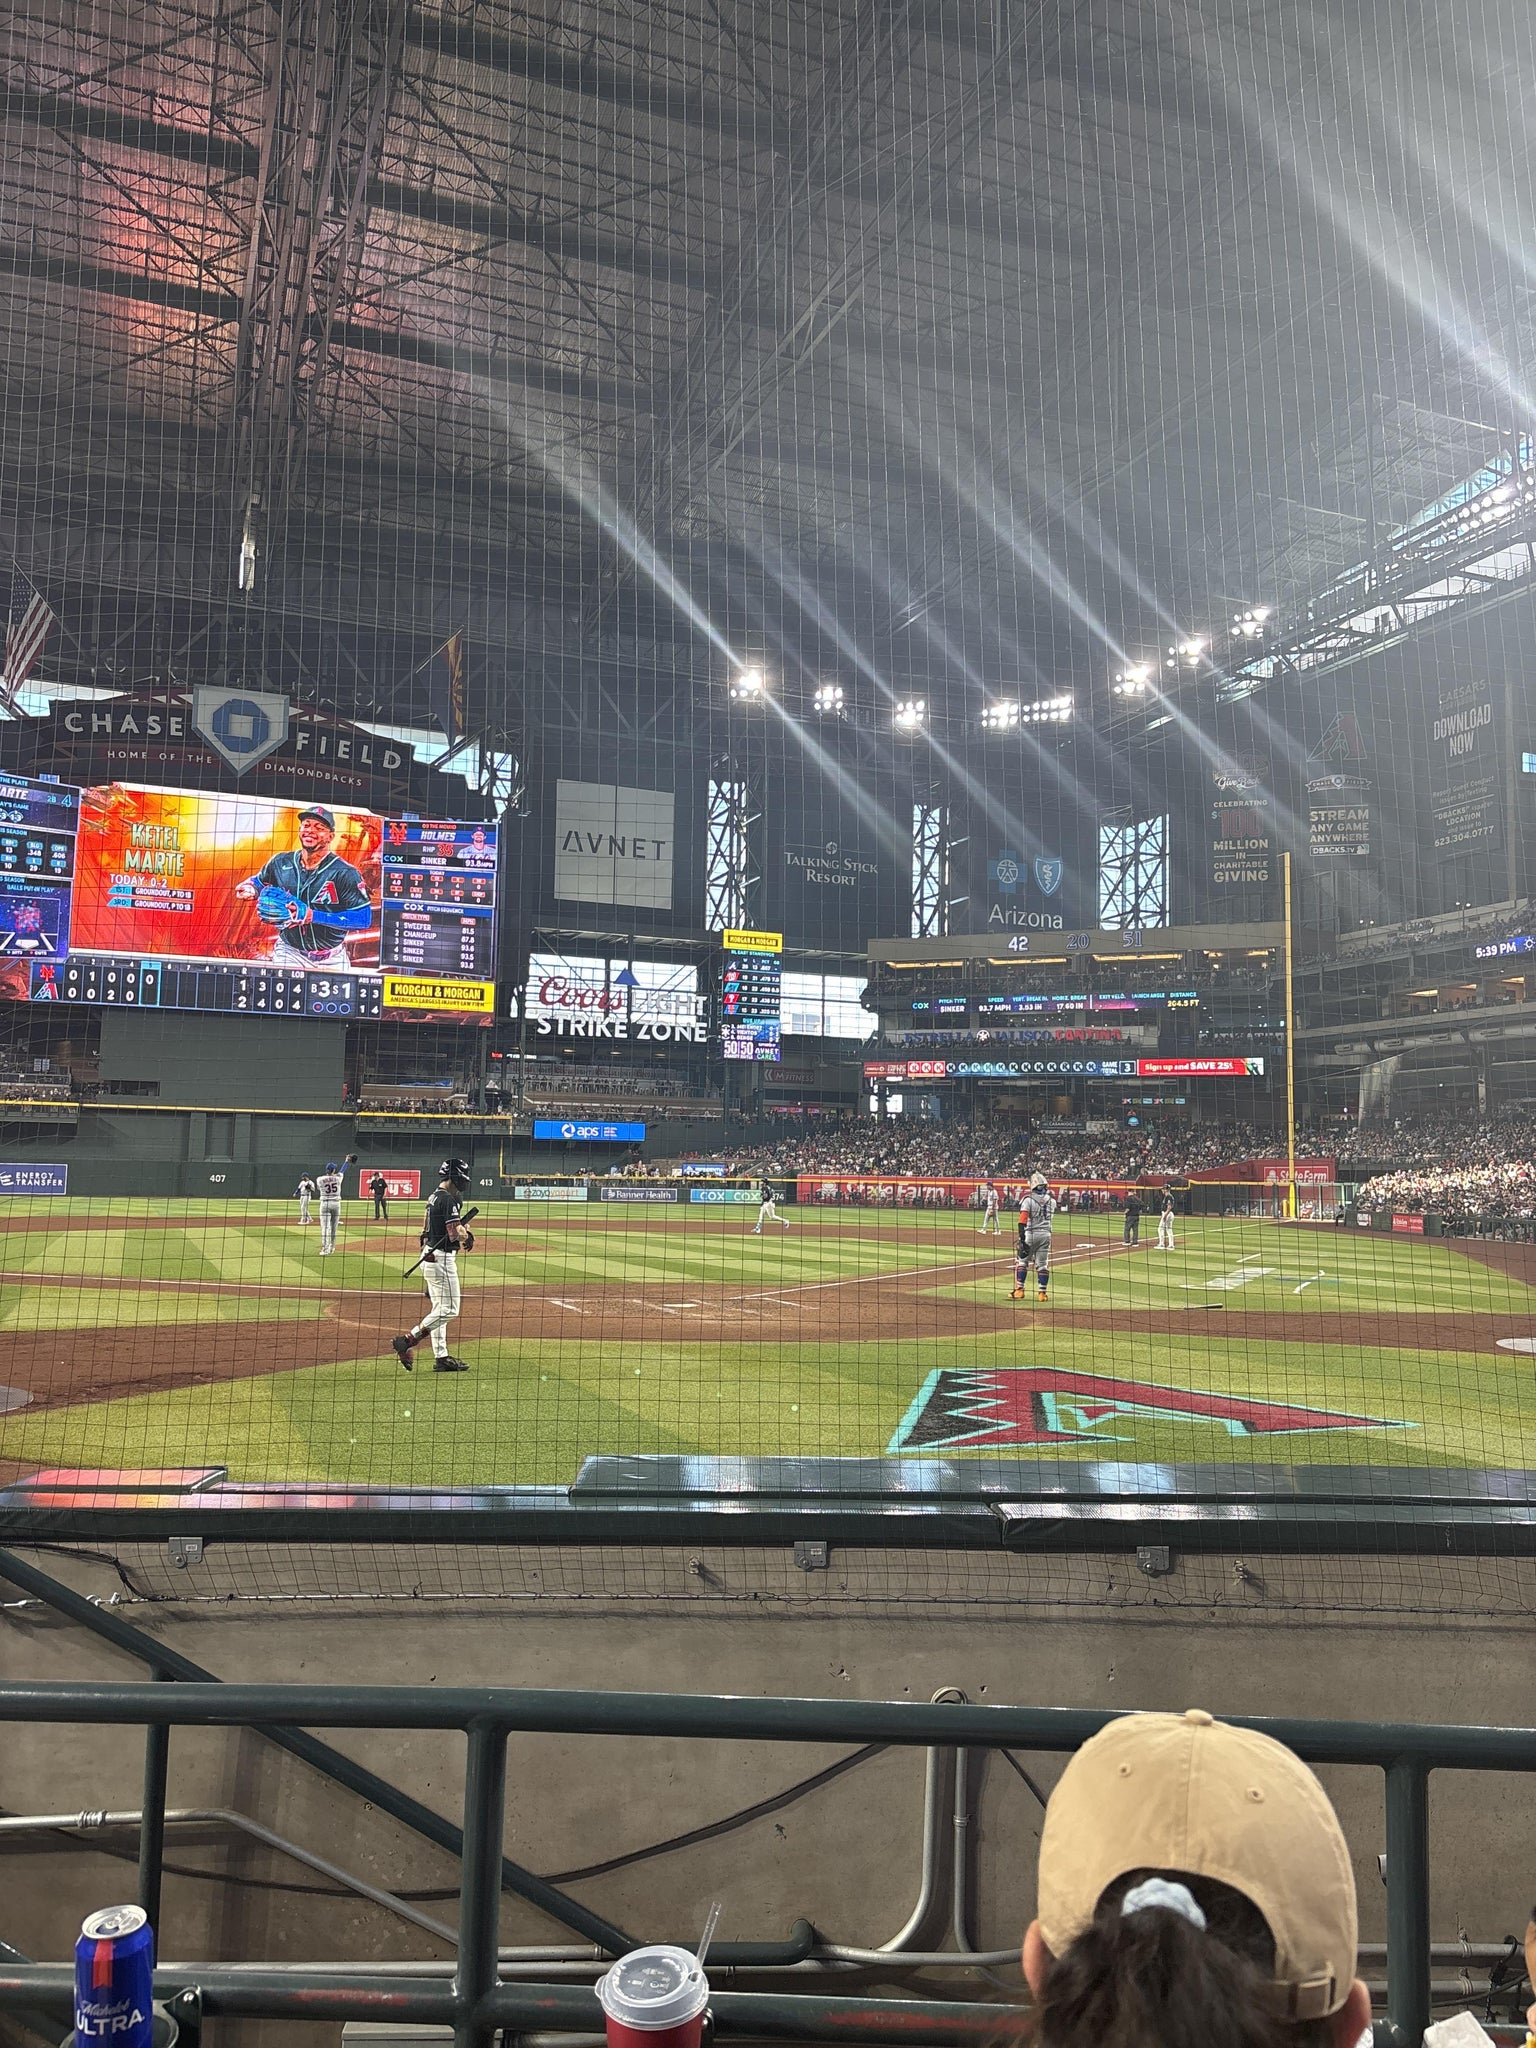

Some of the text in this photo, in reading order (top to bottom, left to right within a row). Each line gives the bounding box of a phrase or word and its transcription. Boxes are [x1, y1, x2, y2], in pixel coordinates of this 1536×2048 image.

[1440, 680, 1486, 703] CAESARS
[64, 713, 183, 736] CHASE
[1434, 704, 1491, 740] DOWNLOAD
[1450, 730, 1474, 757] NOW
[296, 732, 401, 769] FIELD
[108, 751, 147, 759] HOME
[187, 755, 212, 764] THE
[265, 763, 362, 786] DIAMONDBACKS
[12, 778, 28, 786] PLATE
[1218, 777, 1237, 790] Give
[13, 802, 29, 810] GAME
[62, 794, 72, 807] 4
[1310, 809, 1369, 822] STREAM
[1446, 811, 1480, 826] LOCATION
[7, 828, 27, 836] SEASON
[1310, 822, 1369, 832] ANY GAME
[132, 823, 181, 851] KETEL
[421, 831, 456, 841] HOLMES
[1310, 833, 1369, 842] ANYWHERE
[1435, 825, 1494, 847] 623.304.0777
[437, 844, 454, 857] 35
[562, 830, 666, 860] AVNET
[1214, 839, 1268, 850] MILLION
[421, 857, 447, 865] SINKER
[784, 852, 878, 873] TALKING STICK
[1235, 852, 1246, 860] IN
[124, 849, 185, 877] MARTE
[1214, 861, 1268, 869] CHARITABLE
[110, 874, 167, 888] TODAY: 0-2
[806, 869, 856, 885] RESORT
[1214, 870, 1268, 883] GIVING
[135, 888, 171, 897] GROUNDOUT,
[135, 901, 171, 910] GROUNDOUT,
[404, 903, 423, 911] COX
[989, 904, 1062, 929] Arizona
[403, 931, 437, 939] CHANGEUP
[1008, 931, 1143, 951] 42 20 51
[403, 947, 424, 955] SINKER
[1476, 942, 1516, 958] 5:39 PM
[460, 961, 474, 969] 93.8
[69, 970, 301, 994] 0 1 0 0 0 1 3 0 4
[311, 981, 350, 998] B 3 S 1
[360, 989, 379, 998] 2 3
[395, 984, 481, 999] MORGAN & MORGAN
[539, 976, 622, 1010] Coors
[632, 990, 707, 1015] LIGHT
[68, 988, 301, 1010] 0 0 2 0 2 4 0 4
[360, 1005, 378, 1014] 1 4
[940, 1005, 965, 1013] SINKER
[1190, 999, 1199, 1007] FT
[537, 1014, 628, 1038] STRIKE
[637, 1020, 707, 1042] ZONE
[904, 1029, 1122, 1043] ESTRELLA JALISCO CANTINA
[1124, 1063, 1131, 1072] 3
[1145, 1063, 1161, 1071] Sign
[1190, 1062, 1216, 1070] SAVE
[577, 1127, 599, 1138] aps
[210, 1174, 226, 1183] 407
[1304, 1170, 1327, 1182] Farm
[324, 1183, 338, 1194] 35
[616, 1190, 671, 1199] Banner Health
[700, 1192, 725, 1200] COX
[733, 1192, 757, 1201] COX
[76, 2008, 145, 2036] ULTRA
